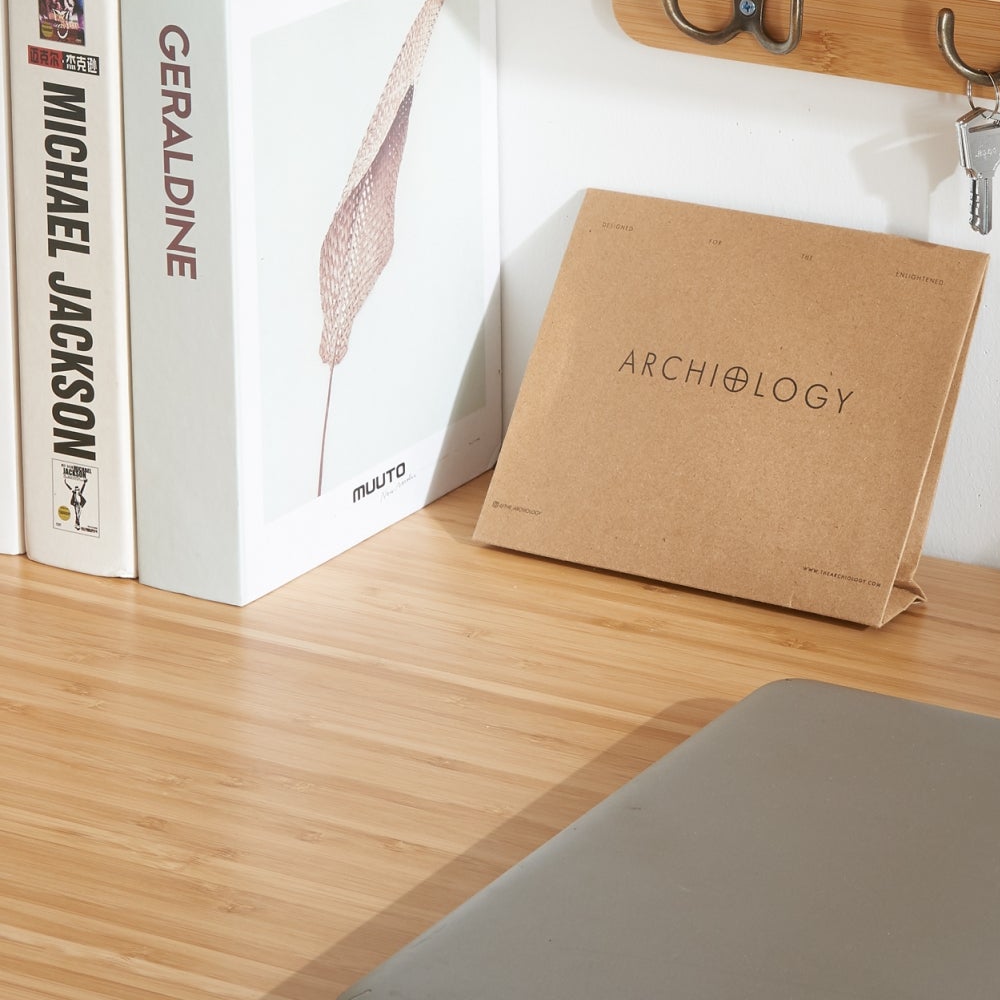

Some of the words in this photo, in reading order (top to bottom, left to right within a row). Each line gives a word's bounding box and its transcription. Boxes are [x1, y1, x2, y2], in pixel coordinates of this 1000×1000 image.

[43, 81, 90, 258] MICHAEL
[159, 24, 197, 280] GERALDINE
[602, 222, 634, 232] DESIGNED
[48, 271, 96, 461] JACKSON
[353, 462, 406, 503] MUUTO
